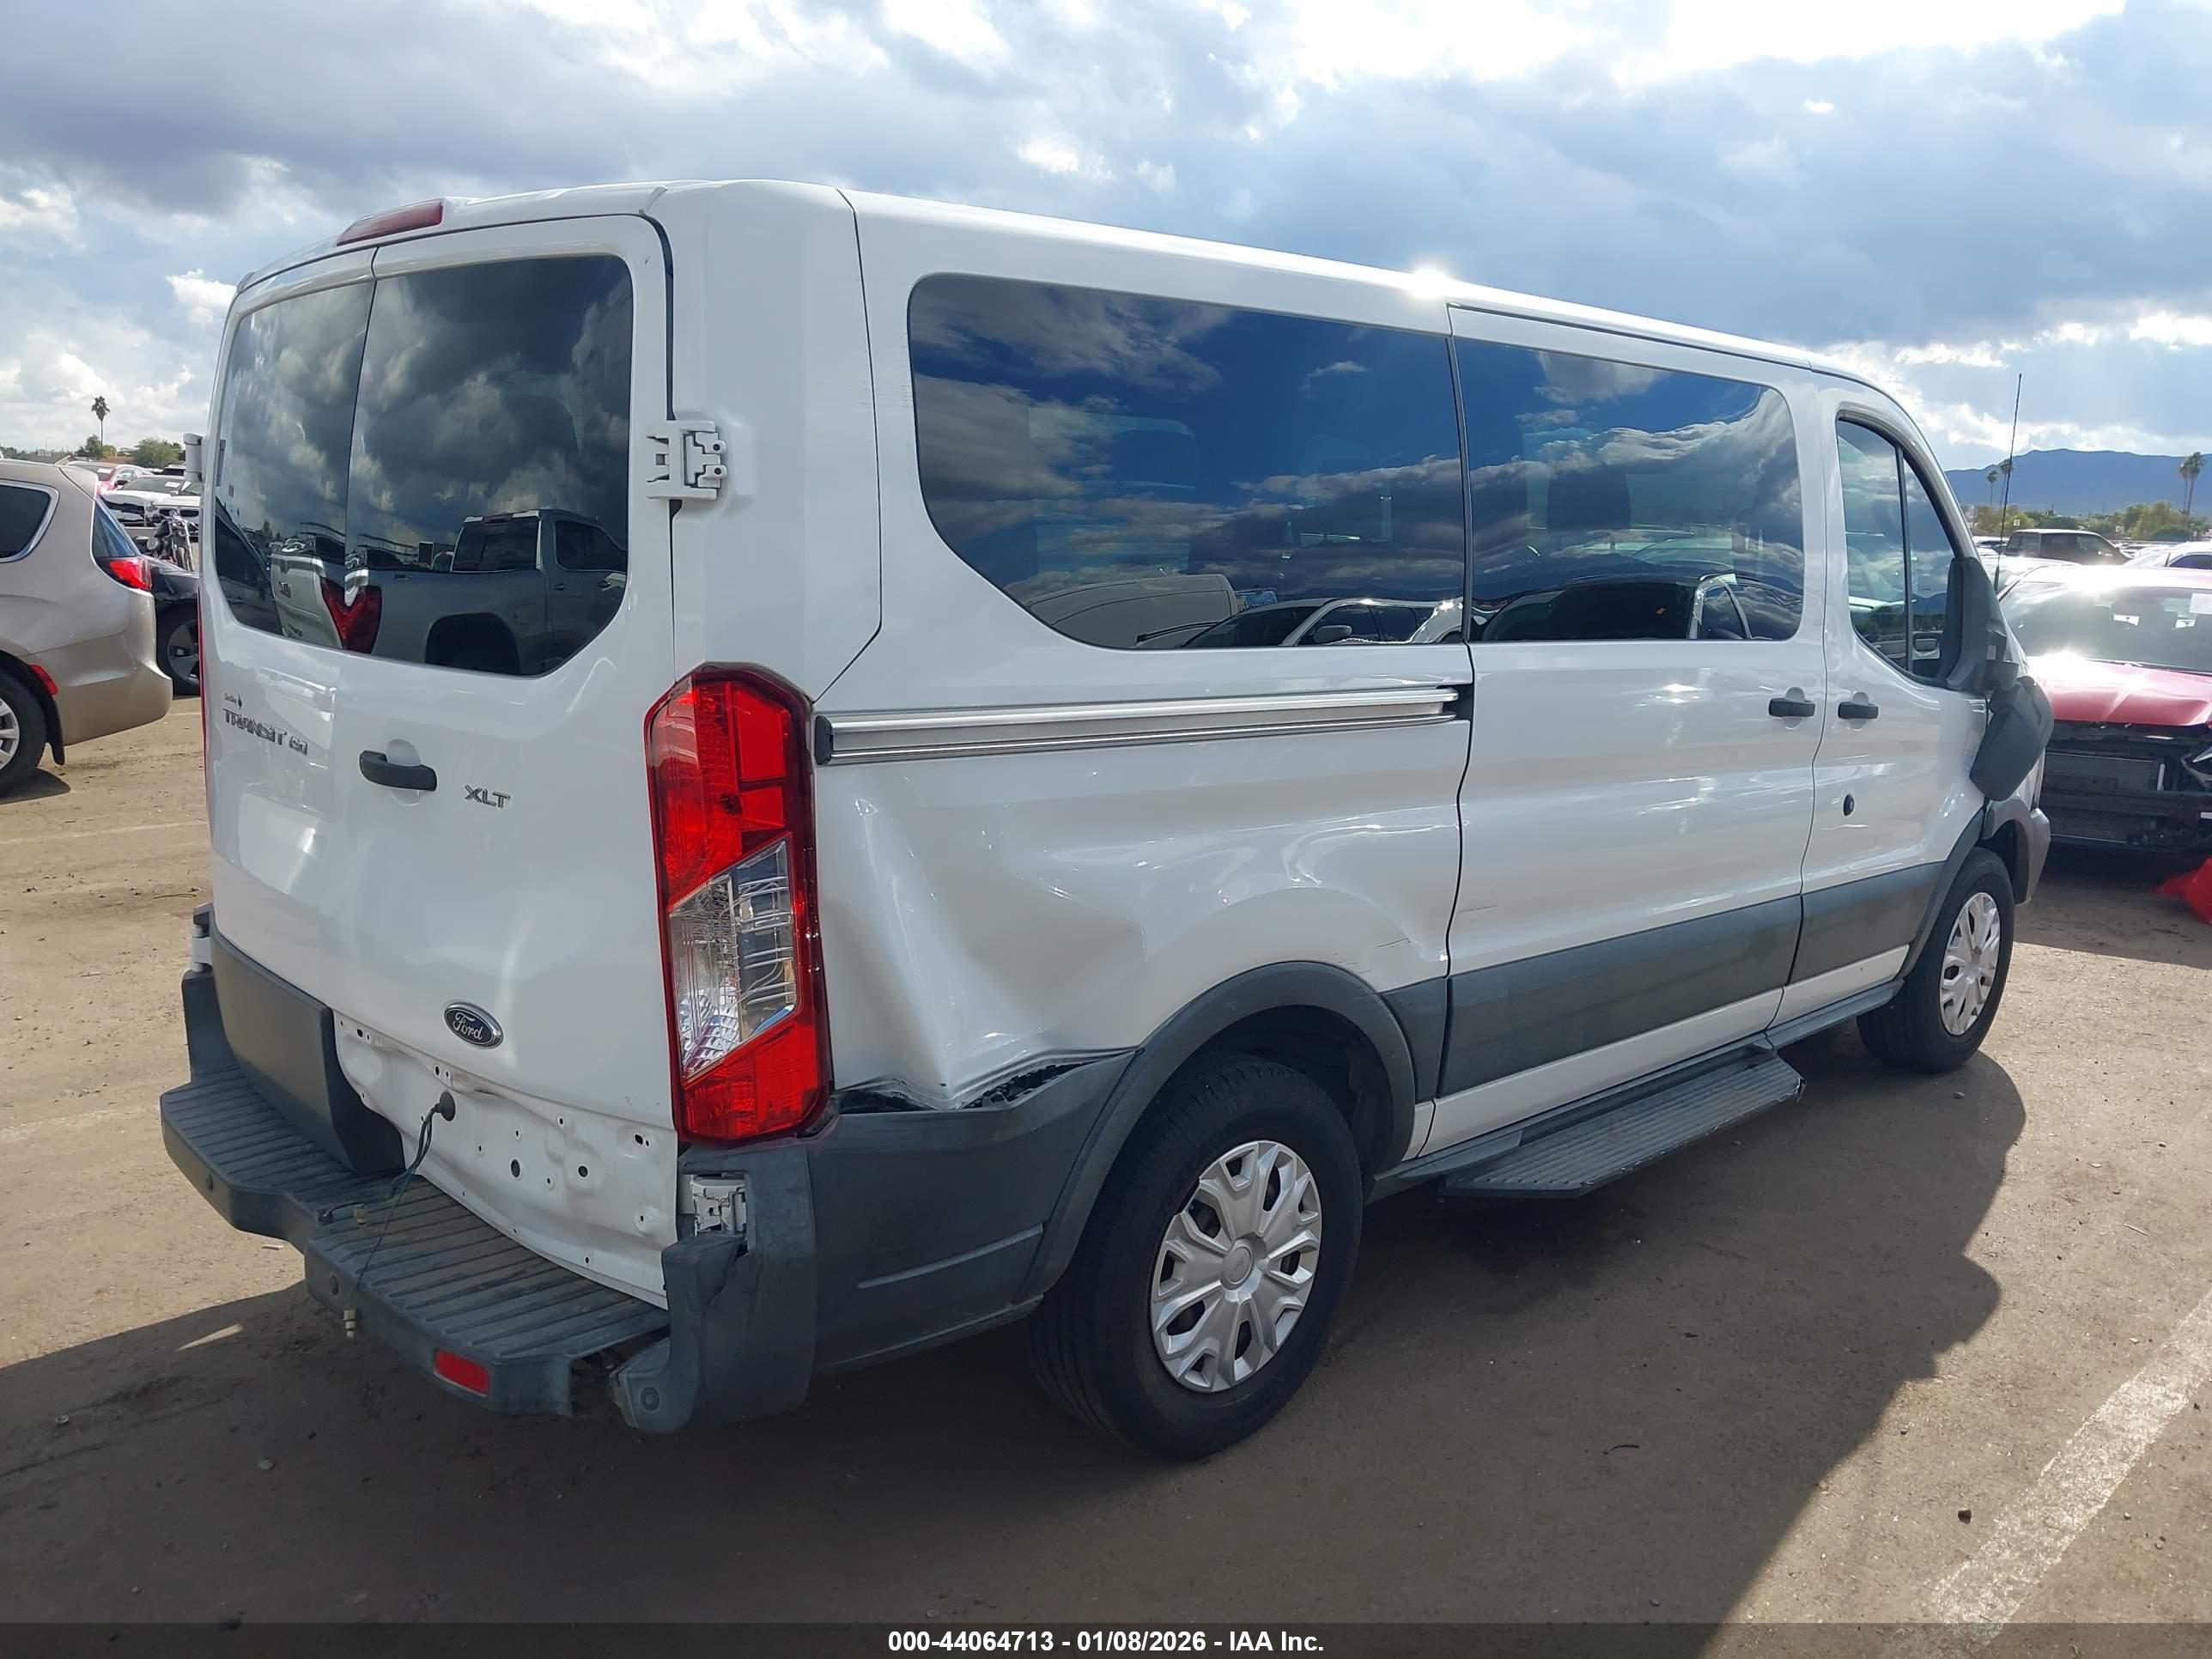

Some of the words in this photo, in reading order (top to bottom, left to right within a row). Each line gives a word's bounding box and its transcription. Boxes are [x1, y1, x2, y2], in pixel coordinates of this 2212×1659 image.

[222, 708, 288, 745] TRANSIT
[465, 784, 510, 809] XLT
[453, 1012, 483, 1040] Ford
